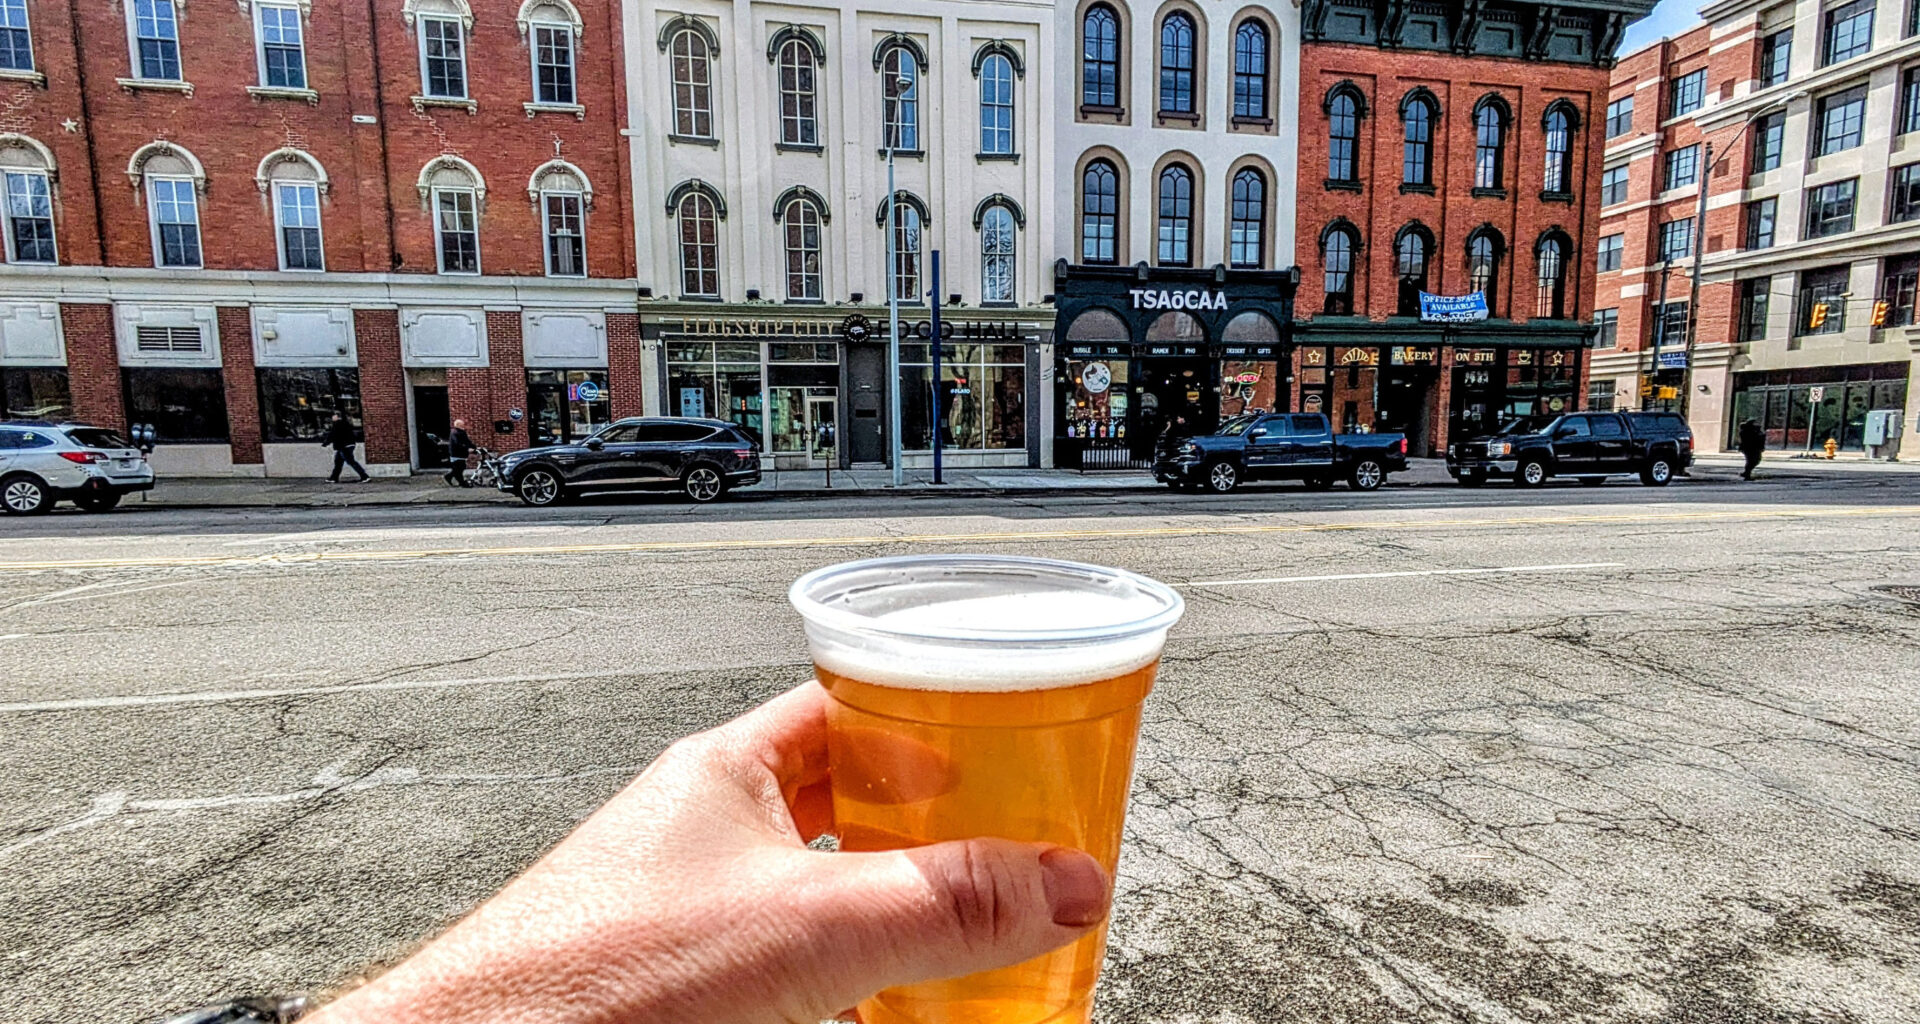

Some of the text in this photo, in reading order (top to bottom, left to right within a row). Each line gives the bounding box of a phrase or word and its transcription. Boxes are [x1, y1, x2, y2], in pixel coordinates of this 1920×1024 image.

[1423, 294, 1481, 303] OFFICE SPACE
[1431, 302, 1477, 311] AVAILABLE
[682, 317, 834, 338] FLAGSHIP CITY
[877, 320, 954, 340] FOOD
[966, 321, 1026, 340] HALL
[1073, 346, 1091, 354] BUBBLE
[1152, 347, 1196, 355] RAMEN PHO
[1226, 347, 1271, 355] DESSERT GIFTS
[1394, 351, 1494, 362] BAKERY ON 5TH
